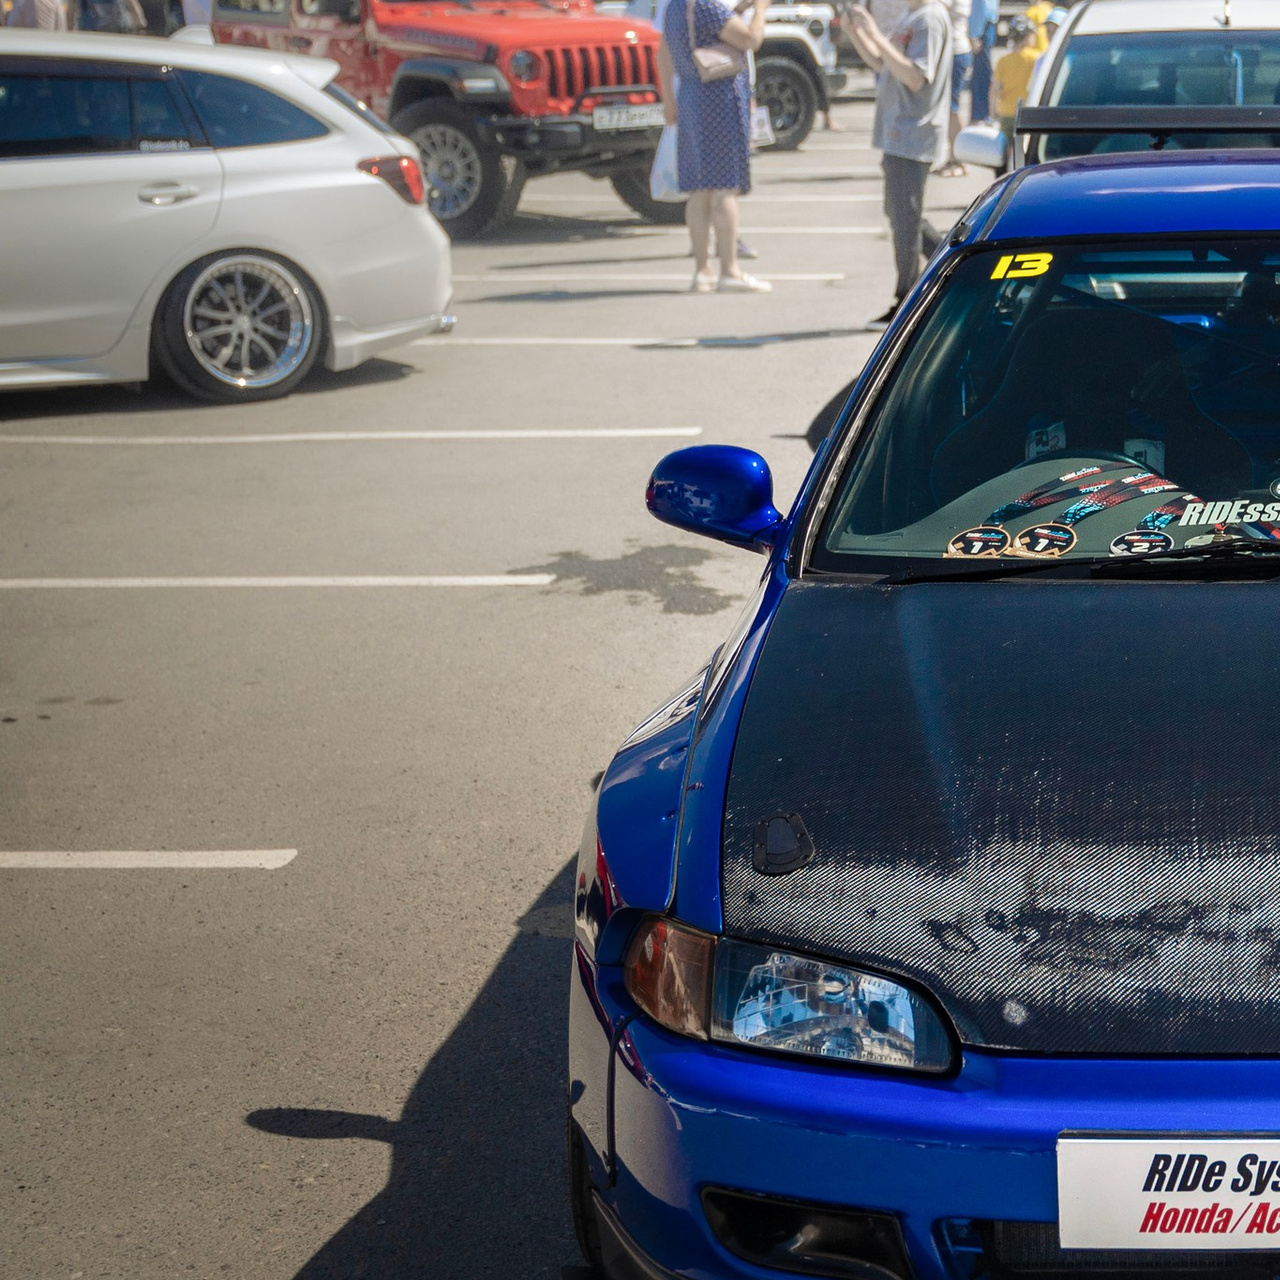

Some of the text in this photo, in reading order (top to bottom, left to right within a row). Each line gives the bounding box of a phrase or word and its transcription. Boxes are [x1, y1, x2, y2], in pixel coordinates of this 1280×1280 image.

[990, 252, 1054, 280] 13
[1131, 542, 1150, 553] 2
[1142, 1153, 1227, 1193] RIDe
